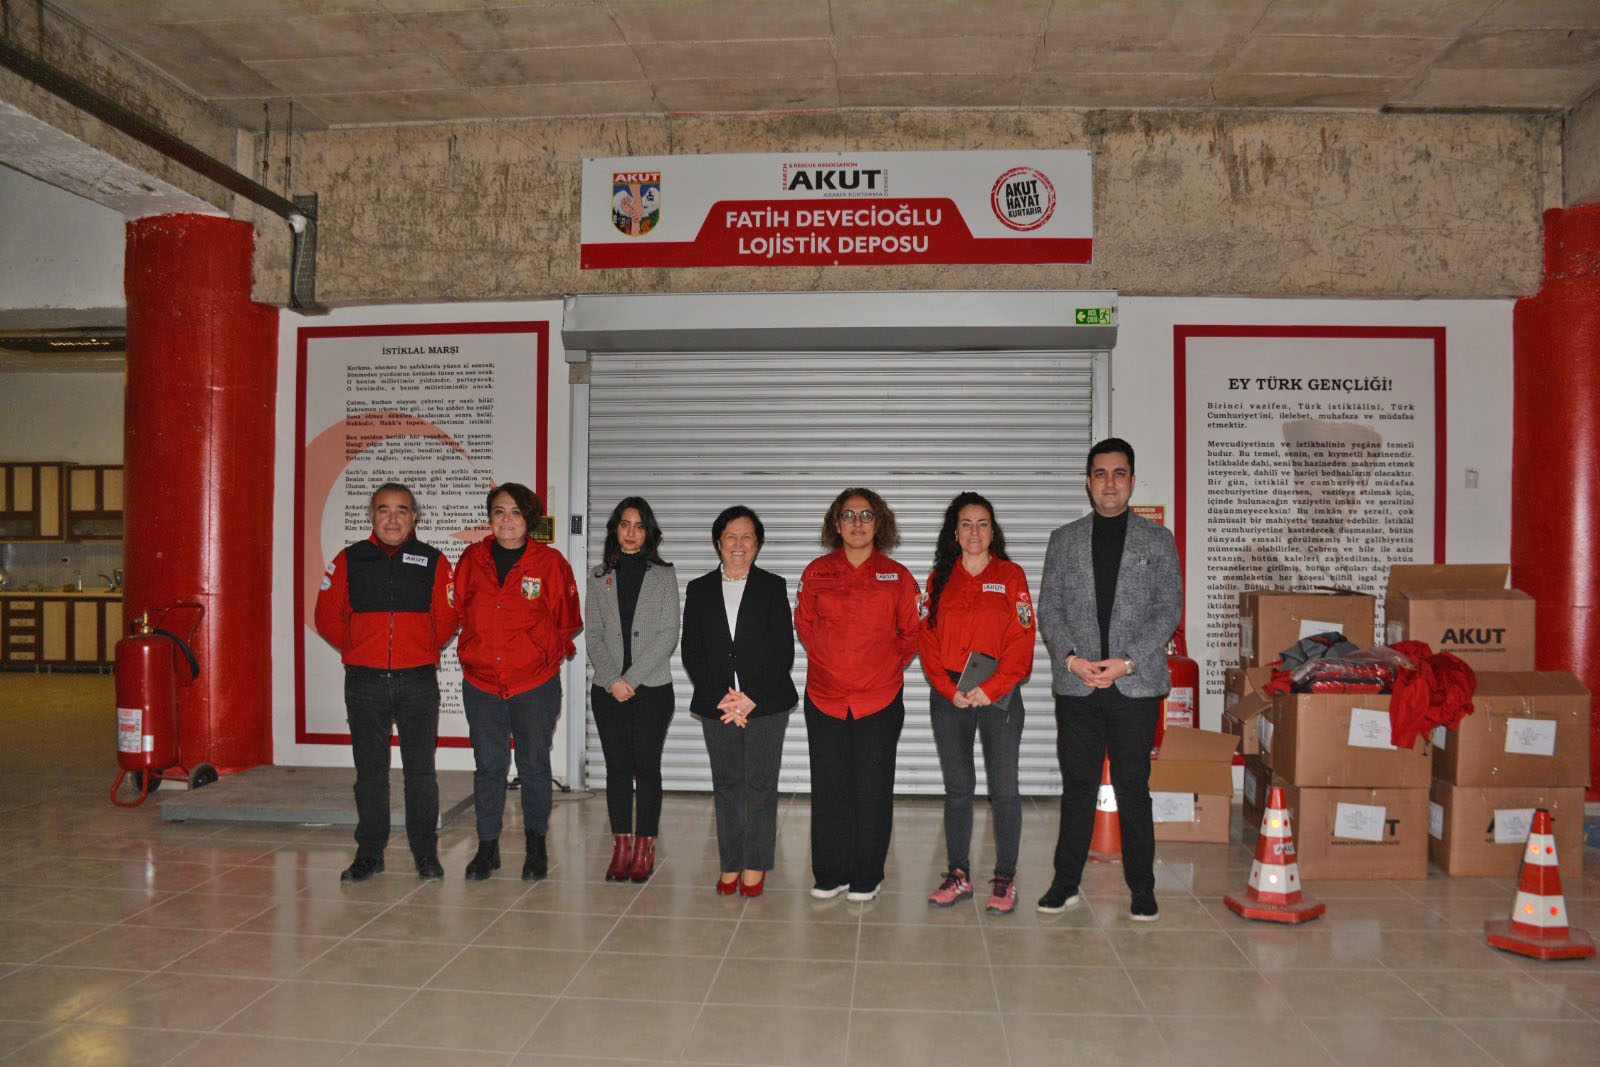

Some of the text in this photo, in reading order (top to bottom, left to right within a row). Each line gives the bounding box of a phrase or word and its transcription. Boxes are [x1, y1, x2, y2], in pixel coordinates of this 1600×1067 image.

[614, 173, 661, 182] AKUT
[788, 170, 881, 190] AKUT
[1006, 180, 1037, 198] AKUT
[1006, 194, 1039, 210] HAYAT
[726, 204, 942, 228] FATİH DEVECİOĞLU
[1008, 207, 1042, 218] KURTARIR
[738, 232, 928, 258] LOJİSTİK DEPOSU
[382, 346, 459, 355] İSTİKLAL MARŞI
[1229, 376, 1392, 393] EY TÜRK GENÇLİĞİ!
[1249, 402, 1291, 411] vazifen,
[1207, 412, 1274, 421] Cumhuriyet'ini,
[1279, 412, 1313, 421] ilelebet,
[1207, 440, 1275, 449] Mevcudiyetinin
[1254, 450, 1281, 459] temel,
[1284, 450, 1310, 459] senin,
[1328, 450, 1363, 459] kıymetli
[1251, 459, 1272, 468] dahi,
[1207, 469, 1250, 478] isteyecek,
[1227, 478, 1248, 487] gün,
[1310, 479, 1368, 488] cumhuriyeti
[1207, 488, 1269, 497] mecburiyetine
[1272, 488, 1313, 497] düşersen,
[1321, 488, 1356, 497] vazifeye
[1395, 488, 1414, 497] için,
[1207, 497, 1234, 506] içinde
[1237, 497, 1288, 506] bulunacağın
[1292, 498, 1331, 506] vaziyetin
[1379, 498, 1414, 506] şeraitini
[1207, 507, 1291, 516] düşünmeyeceksin!
[1398, 507, 1414, 516] çok
[1265, 516, 1308, 525] mahiyette
[1221, 526, 1284, 535] cumhuriyetine
[1207, 535, 1246, 544] dünyada
[1287, 535, 1341, 544] görülmemiş
[1365, 535, 1414, 544] galibiyetin
[1207, 554, 1245, 563] vatanın,
[1358, 573, 1377, 582] işgal
[1440, 628, 1506, 644] AKUT
[1206, 640, 1238, 649] içinde
[1206, 659, 1216, 668] Ey
